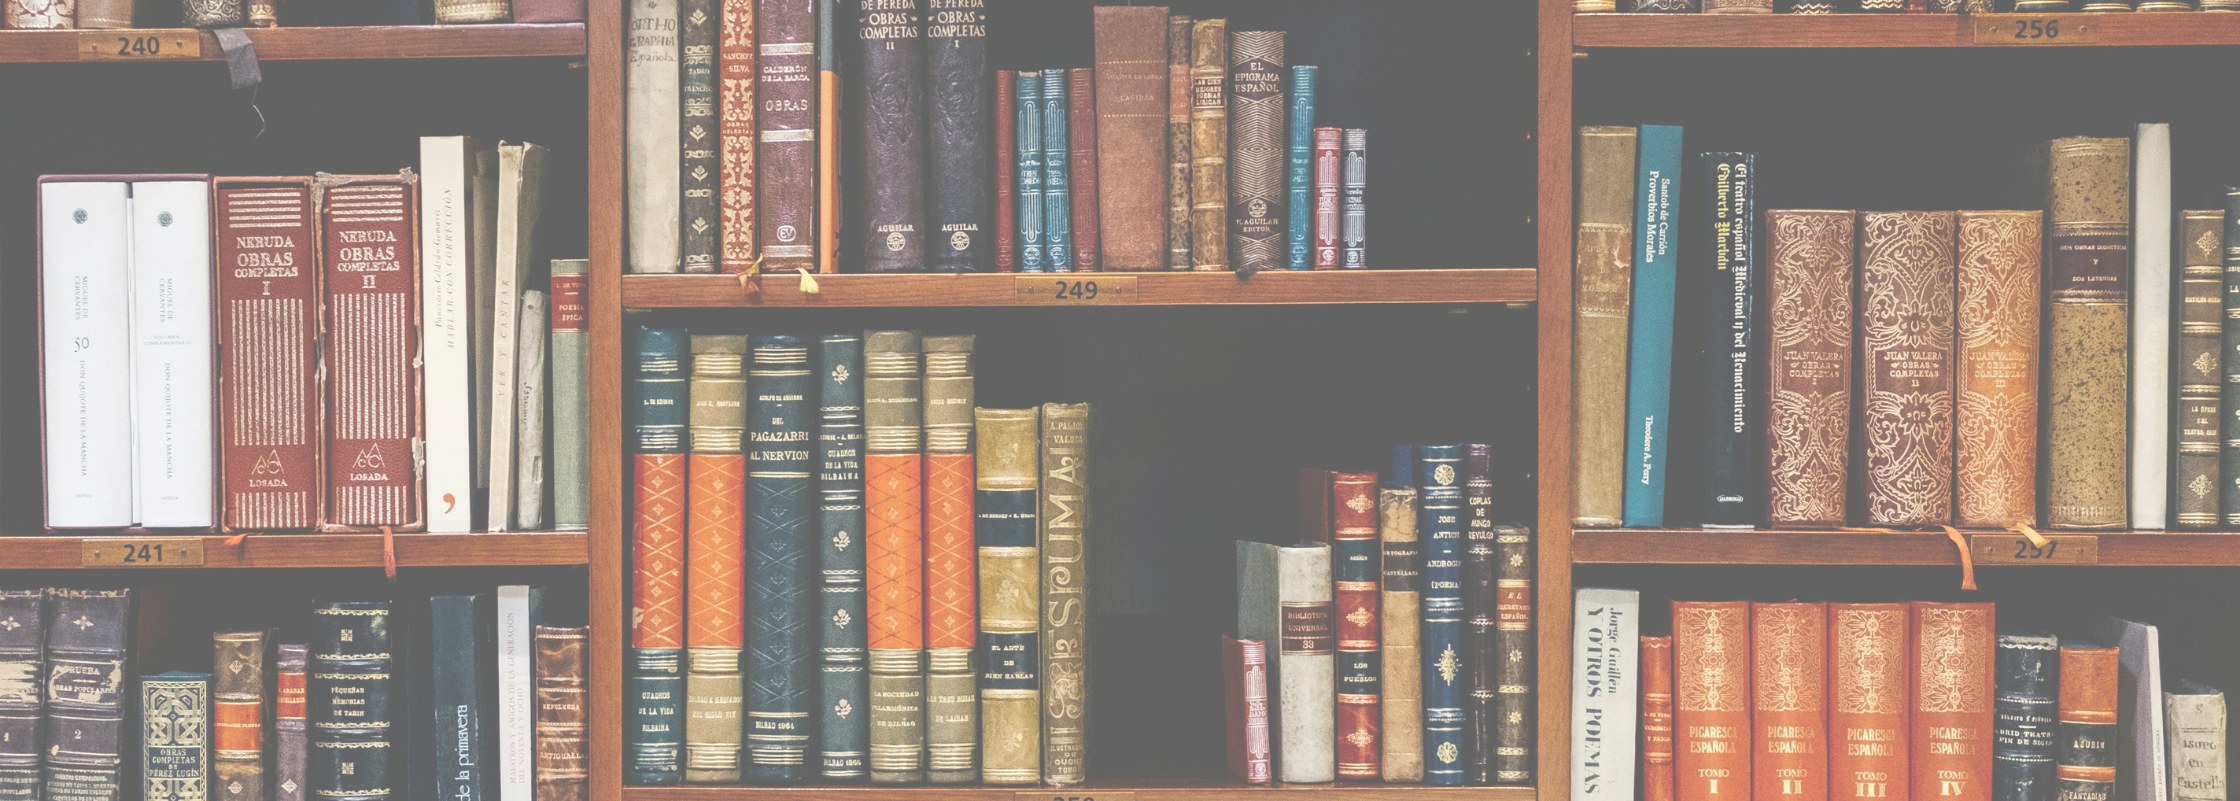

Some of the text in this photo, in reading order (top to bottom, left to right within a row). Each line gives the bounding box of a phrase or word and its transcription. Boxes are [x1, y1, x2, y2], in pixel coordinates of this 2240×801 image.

[861, 0, 916, 10] DE PEREDA
[930, 0, 985, 9] DE PEREDA
[869, 12, 908, 26] OBRAS
[937, 11, 975, 24] OBRAS
[859, 26, 918, 40] COMPLETAS
[927, 25, 986, 37] COMPLETAS
[2015, 19, 2059, 39] 256
[118, 36, 160, 56] 240
[886, 41, 895, 51] II
[954, 39, 960, 49] I
[1249, 62, 1265, 71] EL
[761, 74, 771, 82] DE
[772, 74, 784, 82] LA
[1234, 73, 1280, 82] EPIGRAMA
[1235, 81, 1280, 93] ESPAÑOL
[765, 99, 809, 112] OBRAS
[1645, 169, 1660, 264] Proverbios Morales
[1658, 178, 1671, 256] Santob de Carrión
[877, 223, 915, 233] AGUILAR
[941, 223, 979, 231] AGUILAR
[236, 236, 295, 249] NERUDA
[338, 230, 397, 243] NERUDA
[237, 252, 293, 267] OBRAS
[340, 247, 395, 262] OBRAS
[337, 261, 400, 273] COMPLETAS
[442, 187, 455, 348] HABLAR CON CORRECCIÓN
[2093, 258, 2099, 266] Y
[234, 266, 299, 278] COMPLETAS
[362, 274, 376, 289] II
[262, 281, 271, 296] I
[1055, 280, 1098, 300] 249
[81, 275, 89, 319] MIGUEL DE
[159, 278, 167, 323] CERVANTES
[1731, 163, 1747, 433] El teatro español Medieval y del Renacimiento
[499, 279, 509, 339] CANTAR
[74, 337, 90, 353] 50
[1784, 352, 1844, 361] JUAN VALERA
[1883, 351, 1943, 361] JUAN VALERA
[1968, 352, 2030, 361] JUAN VALERA
[1801, 361, 1832, 369] OBRAS
[1902, 361, 1931, 369] OBRAS
[164, 362, 172, 381] DON
[1789, 369, 1840, 378] COMPLETAS
[1889, 369, 1939, 378] COMPLETAS
[1974, 370, 2026, 378] COMPLETAS
[498, 370, 506, 397] VER
[1994, 379, 2007, 388] III
[78, 381, 87, 415] QUIJOTE
[164, 383, 172, 417] QUIJOTE
[80, 416, 87, 427] DE
[165, 418, 172, 430] DE
[771, 417, 784, 425] DEL
[80, 430, 87, 440] LA
[165, 432, 172, 442] LA
[750, 431, 809, 442] PAGAZARRI
[750, 451, 809, 461] AL NERVION
[827, 449, 856, 458] CUADROS
[1641, 415, 1654, 485] Theodore A. Perry
[350, 472, 389, 481] LOSADA
[820, 473, 859, 481] BILBAINA
[249, 479, 288, 488] LOSADA
[1469, 497, 1491, 505] COPLAS
[1476, 508, 1485, 517] DE
[1471, 519, 1491, 528] MINGO
[123, 543, 163, 563] 241
[1288, 612, 1328, 620] BIBLIOTECA
[1288, 624, 1328, 632] UNIVERSAL
[1606, 607, 1623, 694] Jorge Guillén
[331, 686, 365, 694] PEQUEÑAS
[642, 692, 671, 700] CUADROS
[1584, 607, 1604, 794] Y OTROS POEMAS
[638, 707, 647, 715] DE
[642, 724, 670, 732] BILBAINA
[1689, 725, 1738, 738] PICARESCA
[1767, 725, 1815, 738] PICARESCA
[1847, 727, 1896, 741] PICARESCA
[1929, 726, 1977, 740] PICARESCA
[74, 729, 82, 740] 2
[160, 748, 187, 756] OBRAS
[454, 704, 475, 801] de la primavera
[1690, 740, 1737, 753] ESPAÑOLA
[1768, 740, 1814, 754] ESPAÑOLA
[1847, 742, 1894, 756] ESPAÑOLA
[1929, 741, 1976, 756] ESPAÑOLA
[152, 756, 196, 764] COMPLETAS
[149, 767, 200, 777] PÉREZ LUGÍN
[1697, 768, 1730, 777] TOMO
[1775, 768, 1808, 777] TOMO
[1855, 771, 1887, 781] TOMO
[1936, 770, 1969, 780] TOMO
[1709, 779, 1719, 794] I
[1781, 779, 1804, 795] II
[1855, 782, 1887, 798] III
[1940, 780, 1967, 796] IV
